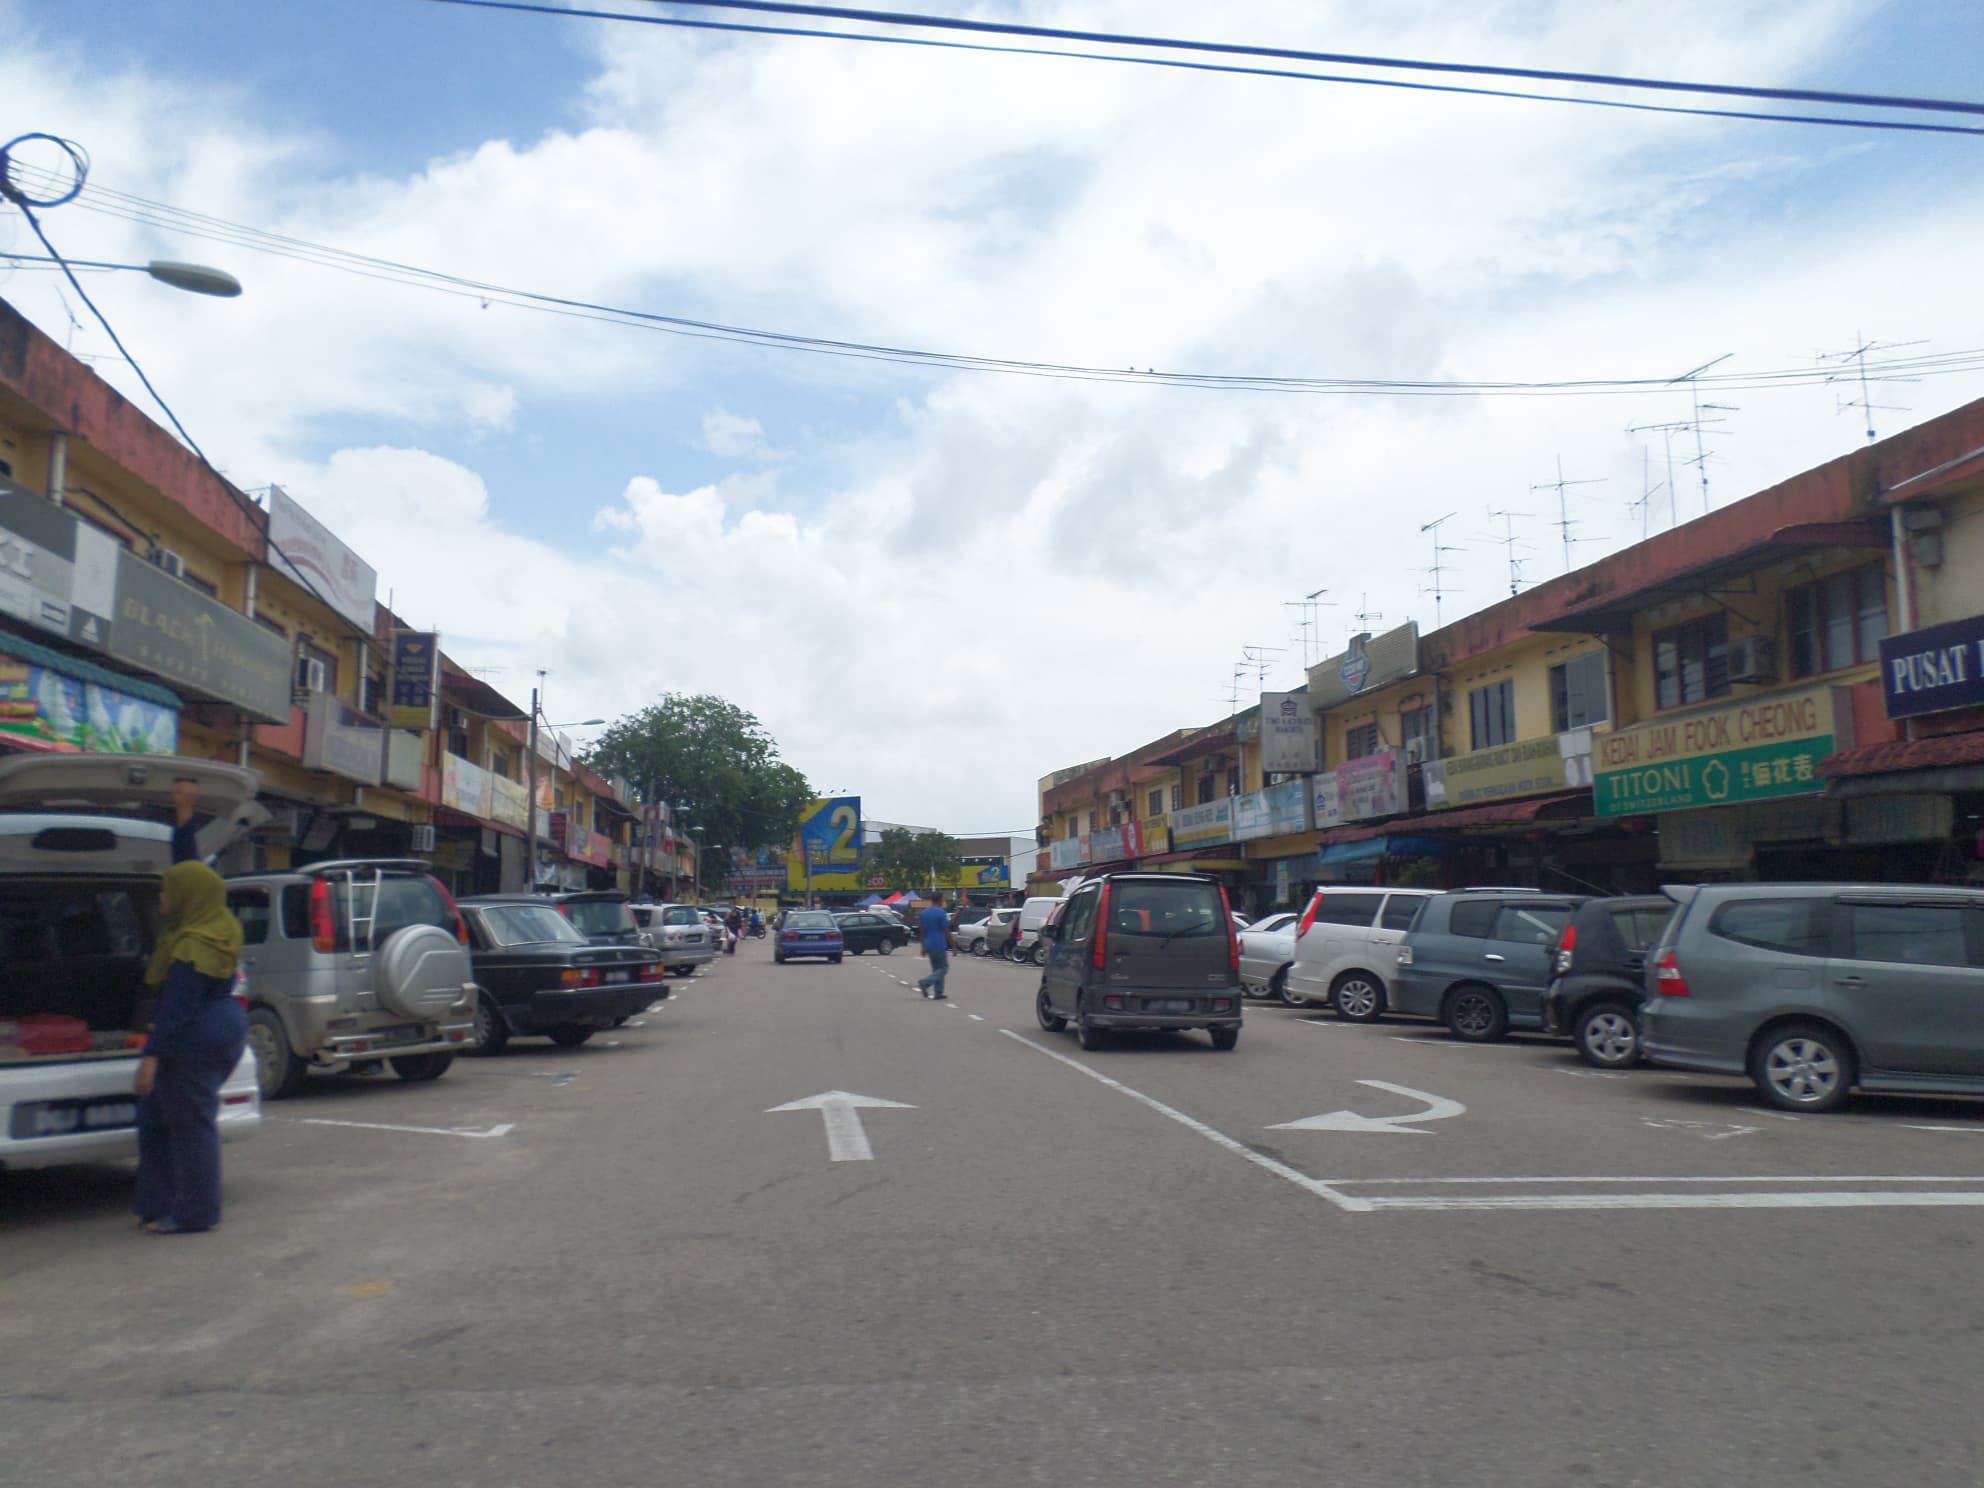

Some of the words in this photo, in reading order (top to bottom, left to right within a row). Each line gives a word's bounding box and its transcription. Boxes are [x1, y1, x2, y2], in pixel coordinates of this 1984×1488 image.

[1891, 644, 1968, 694] PUSAT
[1600, 733, 1639, 767] KEDAI
[1649, 726, 1677, 759] JAM
[1684, 715, 1731, 751] FOOK
[1739, 697, 1817, 742] CHEONG
[1608, 764, 1692, 799] TITONI
[830, 805, 858, 863] 2
